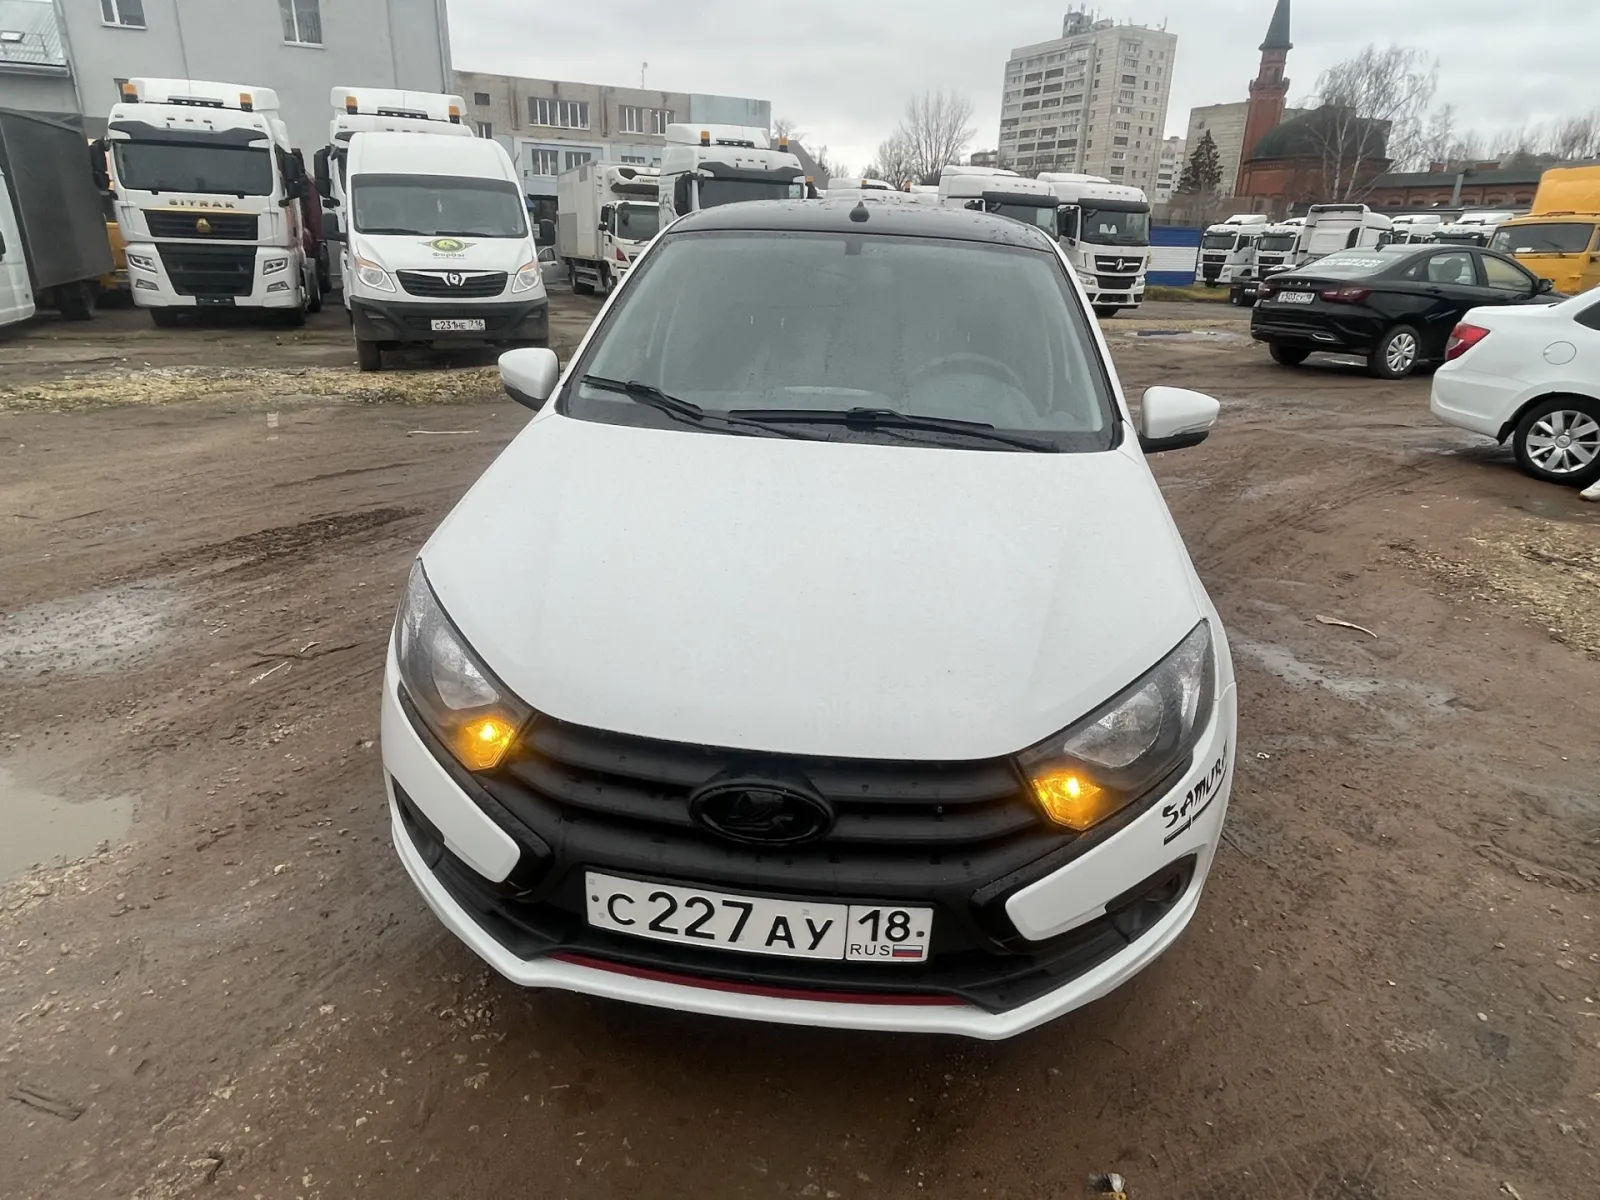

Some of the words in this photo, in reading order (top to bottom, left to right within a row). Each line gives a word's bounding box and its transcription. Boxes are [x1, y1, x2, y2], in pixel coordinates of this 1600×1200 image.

[169, 199, 234, 208] SITRAK
[858, 909, 910, 942] 18
[850, 944, 890, 956] RUS
